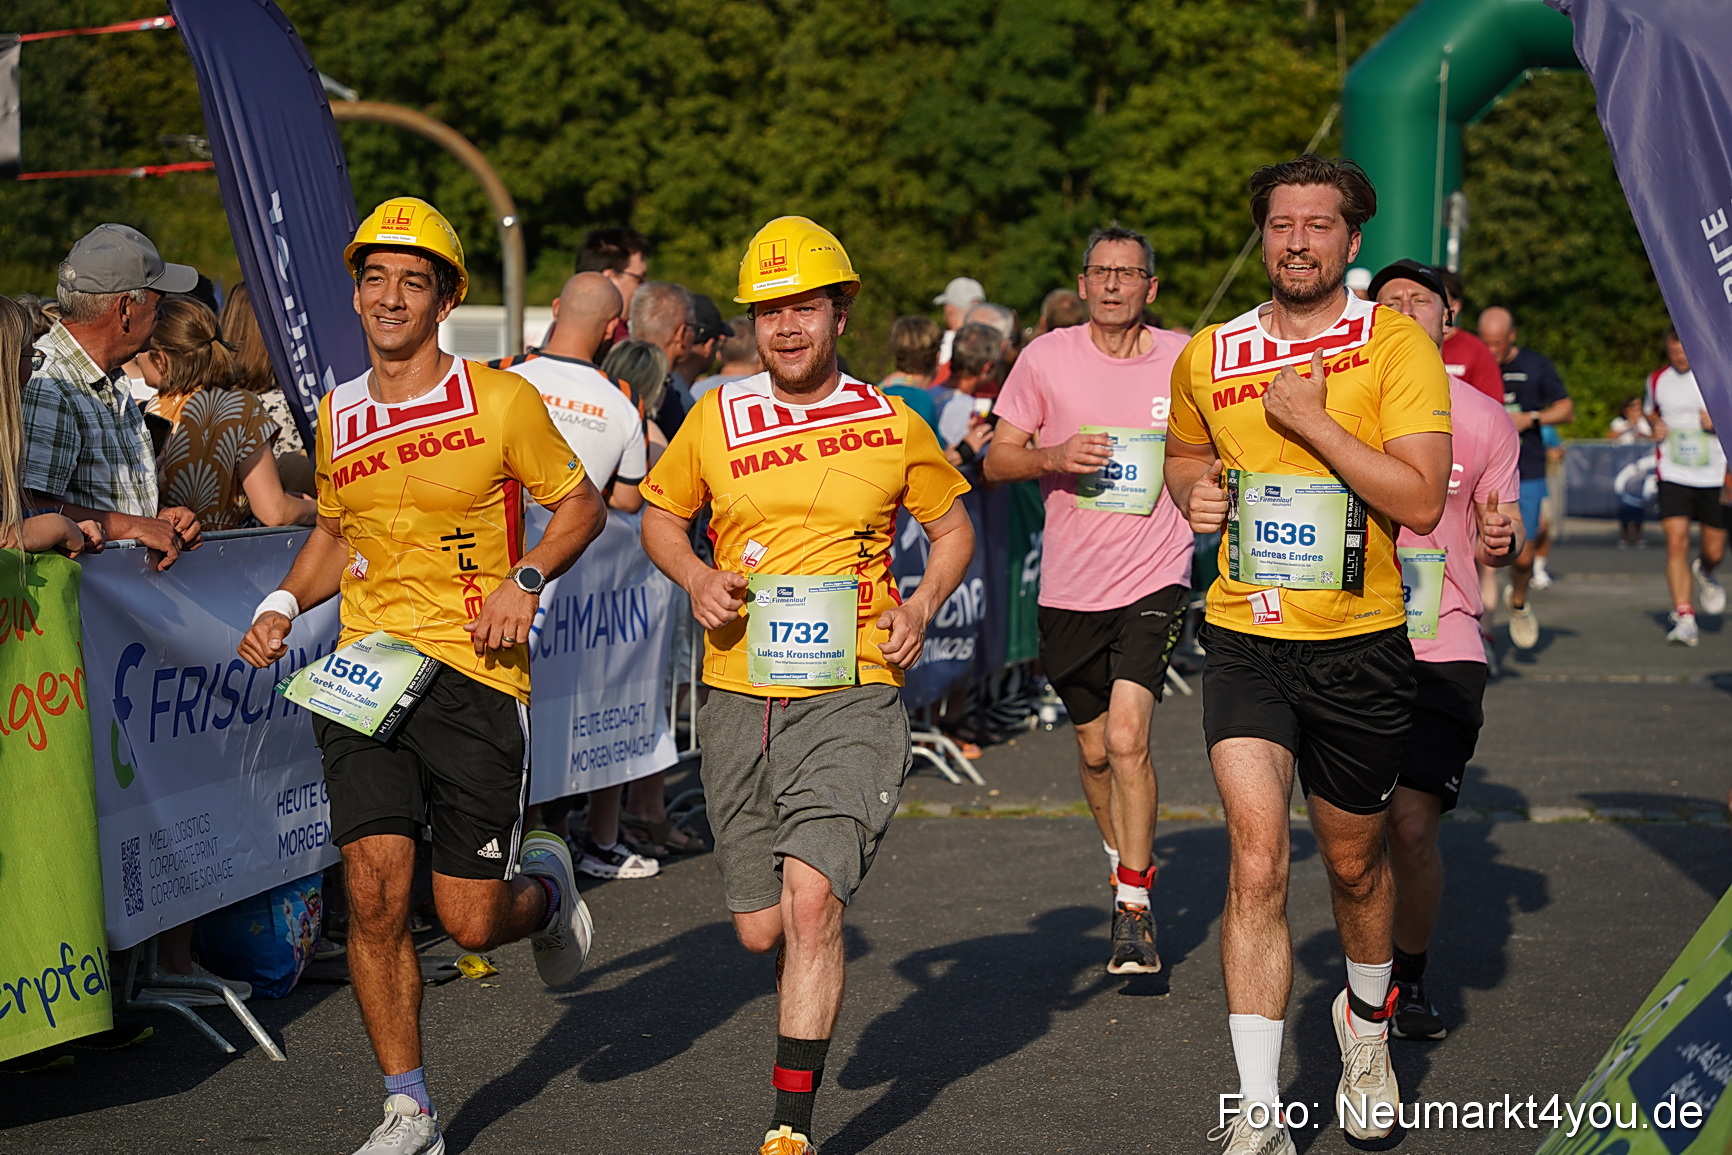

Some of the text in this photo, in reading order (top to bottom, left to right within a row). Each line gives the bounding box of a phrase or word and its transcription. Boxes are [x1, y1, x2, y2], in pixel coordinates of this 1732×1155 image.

[541, 394, 608, 420] KLEBL
[332, 427, 485, 491] MAX BÖGL
[730, 428, 903, 479] MAX BÖGL
[1255, 520, 1316, 546] 1636
[1251, 548, 1323, 562] Andreas Endres
[1346, 550, 1355, 582] HILTL
[769, 621, 829, 644] 1732
[758, 648, 844, 658] Lukas Kronschnabl
[323, 653, 383, 692] 1584
[309, 672, 334, 689] Tarek
[336, 684, 378, 709] Abu-Zalam
[379, 707, 402, 733] HILTL
[572, 711, 600, 738] HEUTE
[570, 743, 612, 774] MORGEN
[277, 782, 317, 817] HEUTE
[278, 820, 331, 859] MORGEN
[477, 849, 502, 859] adidas
[150, 836, 218, 879] CORPORATE PRINT
[151, 858, 233, 906] CORPORATE SIGNAGE
